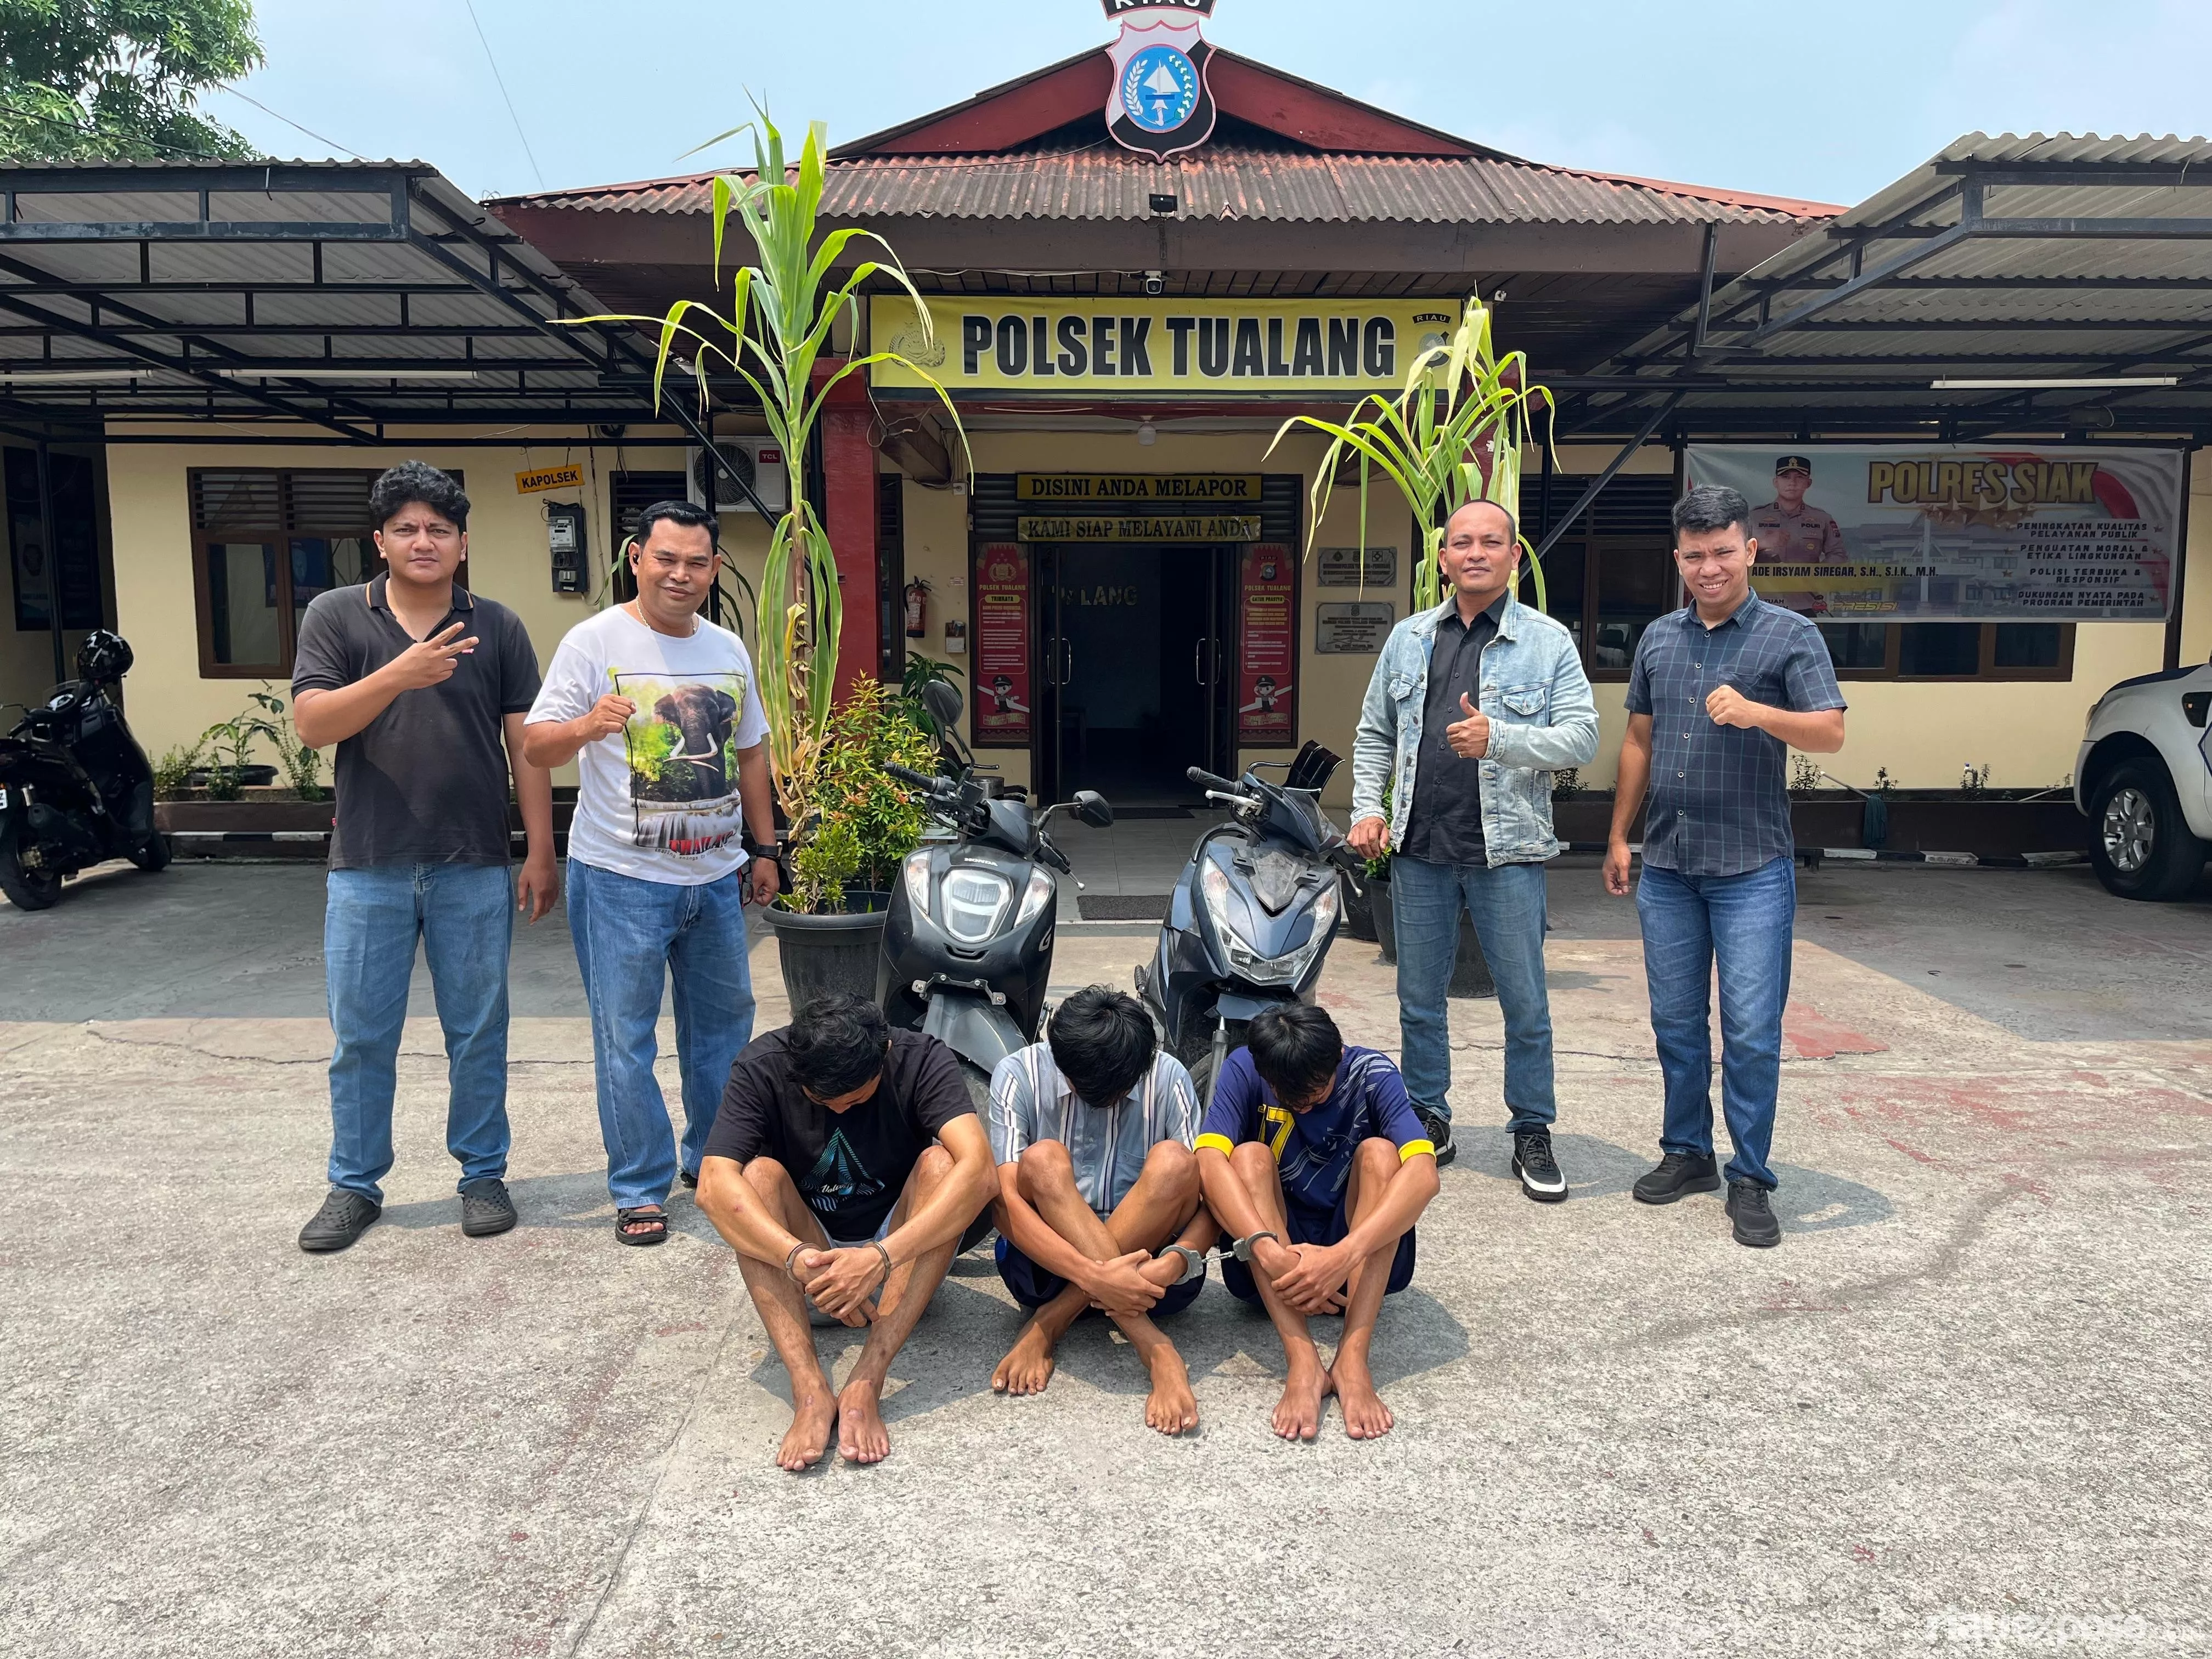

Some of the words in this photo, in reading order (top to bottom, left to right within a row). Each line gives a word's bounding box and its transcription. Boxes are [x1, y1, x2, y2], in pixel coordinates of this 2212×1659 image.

[963, 315, 1153, 377] POLSEK
[1165, 317, 1396, 377] TUALANG
[522, 470, 579, 488] KAPOLSEK
[1031, 479, 1091, 496] DISINI
[1096, 479, 1149, 496] ANDA
[1155, 479, 1248, 496] MELAPOR
[1867, 461, 2007, 504] POLRES
[2010, 461, 2099, 504] SIAK
[1028, 520, 1071, 538] KAMI
[1076, 520, 1113, 538] SIAP
[1118, 520, 1203, 537] MELAYANI
[1207, 520, 1252, 537] ANDA
[1752, 566, 1770, 577] ADE
[1773, 566, 1810, 577] IRSYAM
[1813, 566, 1857, 578] SIREGAR,
[1860, 567, 1882, 578] S.H.,
[964, 857, 998, 867] HONDA
